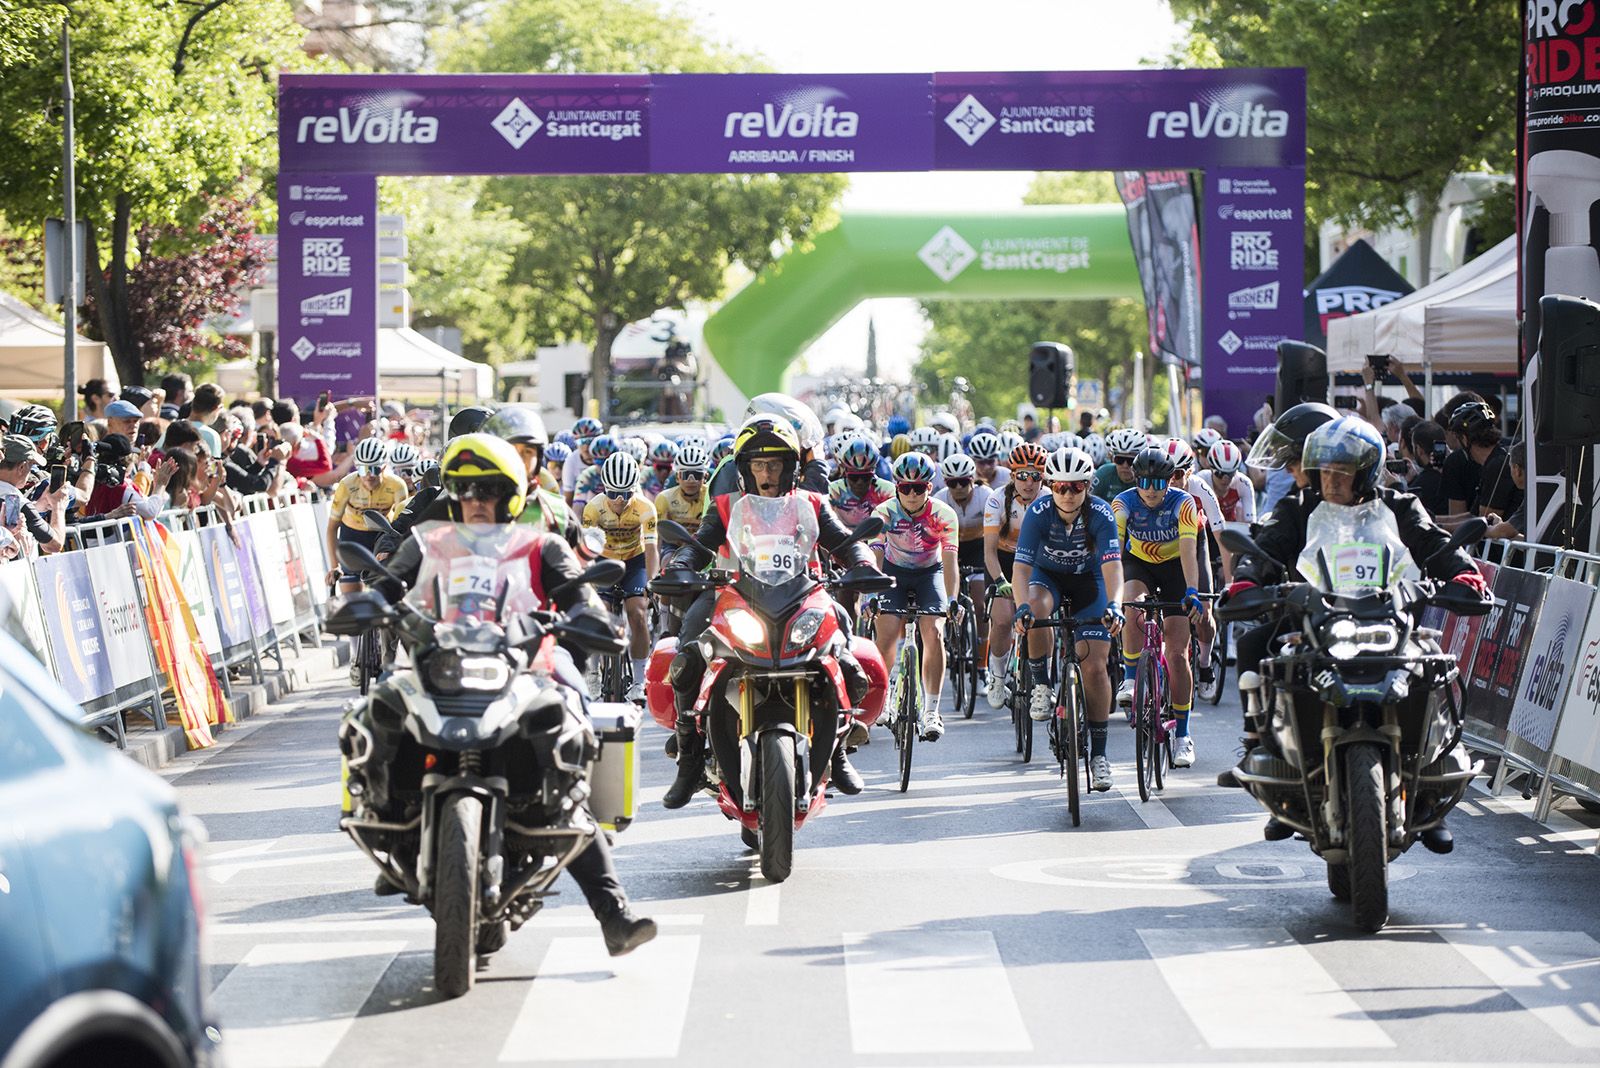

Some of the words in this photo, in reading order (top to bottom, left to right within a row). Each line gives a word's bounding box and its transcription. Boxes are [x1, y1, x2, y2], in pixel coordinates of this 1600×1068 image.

[547, 110, 623, 121] AJUNTAMENT
[625, 110, 641, 121] DE
[1001, 106, 1075, 117] AJUNTAMENT
[1078, 106, 1095, 117] DE
[297, 106, 440, 144] reVolta
[724, 102, 859, 138] reVolta
[1000, 117, 1095, 137] SantCugat
[1147, 101, 1290, 139] reVolta
[546, 121, 642, 140] SantCugat
[728, 150, 798, 162] ARRIBADA
[800, 150, 807, 162] /
[809, 149, 855, 162] FINISH
[304, 214, 364, 228] esportcat
[1234, 208, 1292, 222] esportcat
[303, 241, 343, 257] PRO
[981, 237, 1067, 250] AJUNTAMENT
[1071, 237, 1089, 250] DE
[1231, 235, 1271, 250] PRO
[303, 256, 351, 273] RIDE
[981, 250, 1090, 273] SantCugat
[1231, 250, 1279, 267] RIDE
[1032, 500, 1051, 515] Liv
[772, 553, 792, 569] 96
[1355, 564, 1377, 580] 97
[470, 575, 491, 592] 74
